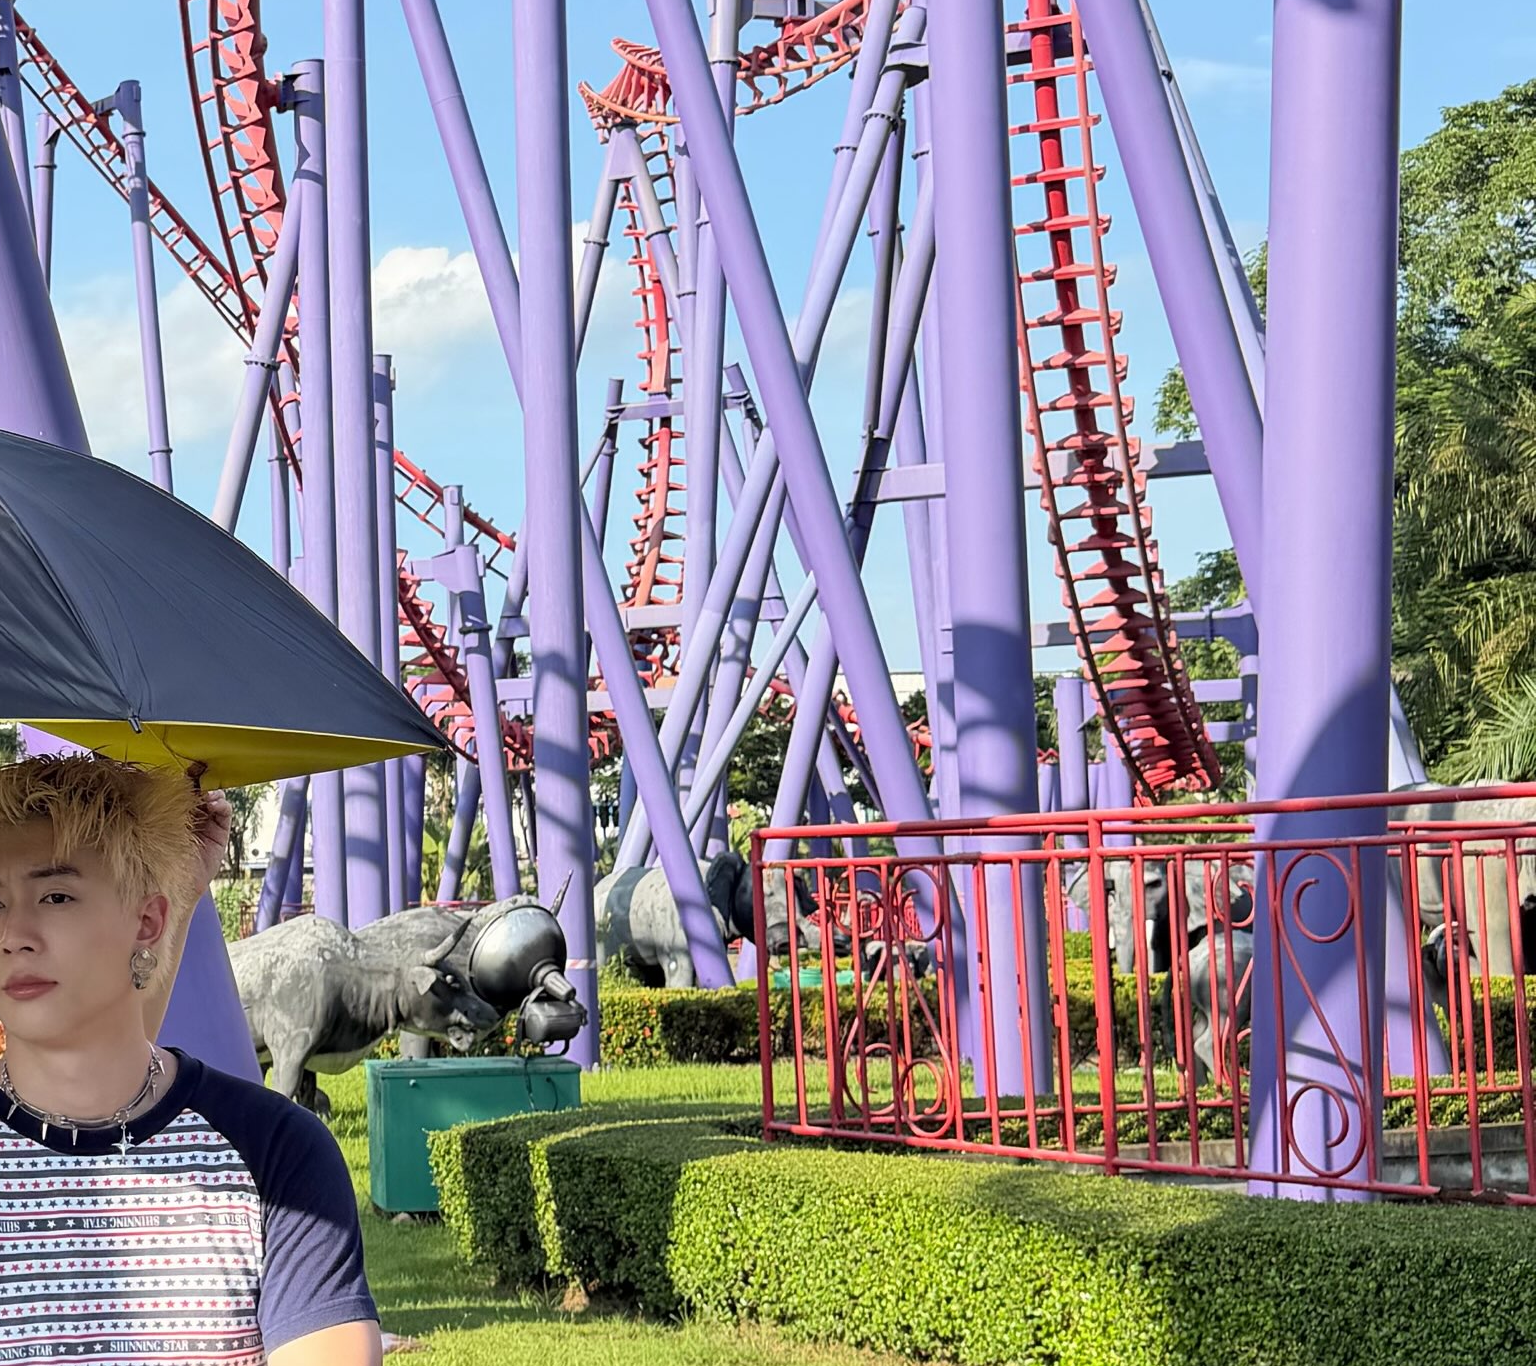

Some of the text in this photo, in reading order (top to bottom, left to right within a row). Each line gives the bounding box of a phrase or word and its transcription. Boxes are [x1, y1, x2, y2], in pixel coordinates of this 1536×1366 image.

[82, 1215, 160, 1228] SHINNING STAR
[28, 1344, 53, 1356] STAR
[110, 1339, 189, 1352] SHINNING STAR
